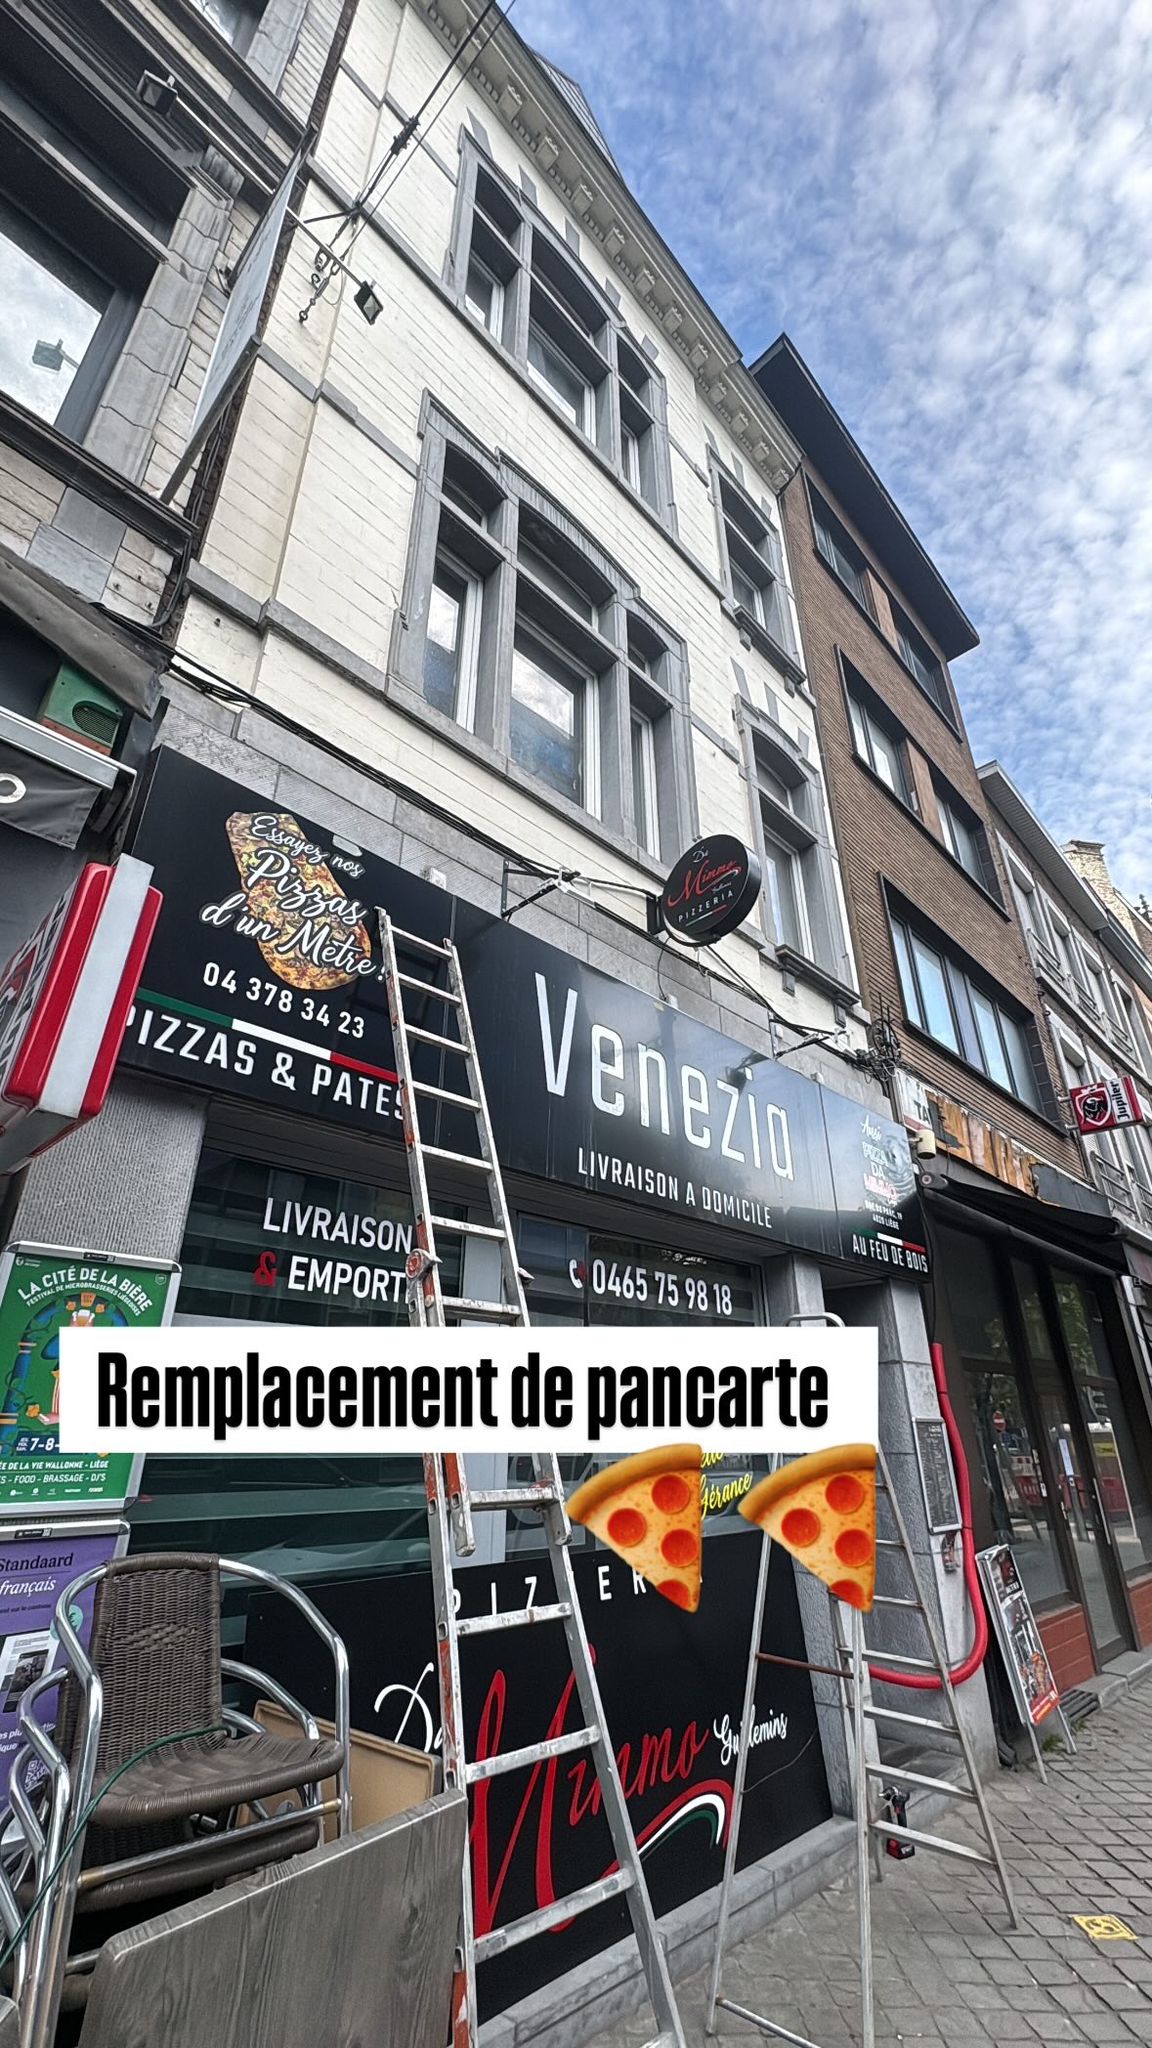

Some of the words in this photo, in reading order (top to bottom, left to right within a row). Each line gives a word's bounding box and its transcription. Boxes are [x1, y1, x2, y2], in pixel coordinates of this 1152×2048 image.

[251, 815, 328, 863] Essayez
[332, 856, 364, 877] nos
[248, 850, 366, 924] Pizzas
[678, 890, 733, 922] PIZZERIA
[201, 893, 279, 941] d'un
[203, 962, 237, 994] 04
[246, 977, 293, 1013] 378
[300, 997, 330, 1027] 34
[337, 1011, 365, 1039] 23
[271, 1051, 296, 1091] &
[534, 972, 795, 1181] Venezia
[1110, 1081, 1130, 1120] Jupiler
[578, 1147, 679, 1201] LIVRAISON
[685, 1182, 696, 1206] A
[702, 1186, 772, 1229] DOMICILE
[870, 1161, 886, 1180] DA
[263, 1197, 413, 1254] LIVRAISON
[255, 1250, 278, 1288] &
[852, 1233, 867, 1256] AU
[869, 1238, 889, 1262] FEU
[890, 1245, 905, 1267] DE
[905, 1249, 928, 1273] BOIS
[17, 1281, 42, 1300] LA
[42, 1265, 77, 1287] CITÉ
[79, 1267, 99, 1281] DE
[100, 1270, 118, 1287] LA
[118, 1278, 153, 1312] BIÈRE
[26, 1288, 55, 1307] FESTIVAL
[55, 1284, 64, 1292] DE
[65, 1282, 118, 1296] MICROBRASSERIES
[592, 1259, 648, 1301] 0465
[654, 1271, 679, 1307] 75
[685, 1277, 708, 1311] 98
[713, 1283, 733, 1316] 18
[8, 1462, 19, 1470] DE
[19, 1462, 29, 1470] LA
[31, 1461, 44, 1470] VIE
[45, 1460, 84, 1470] WALLONNE
[14, 1474, 36, 1484] FOOD
[43, 1473, 85, 1484] BRASSAGE
[90, 1473, 106, 1482] DJ'S
[0, 1552, 73, 1572] Standaard
[0, 1576, 56, 1598] français
